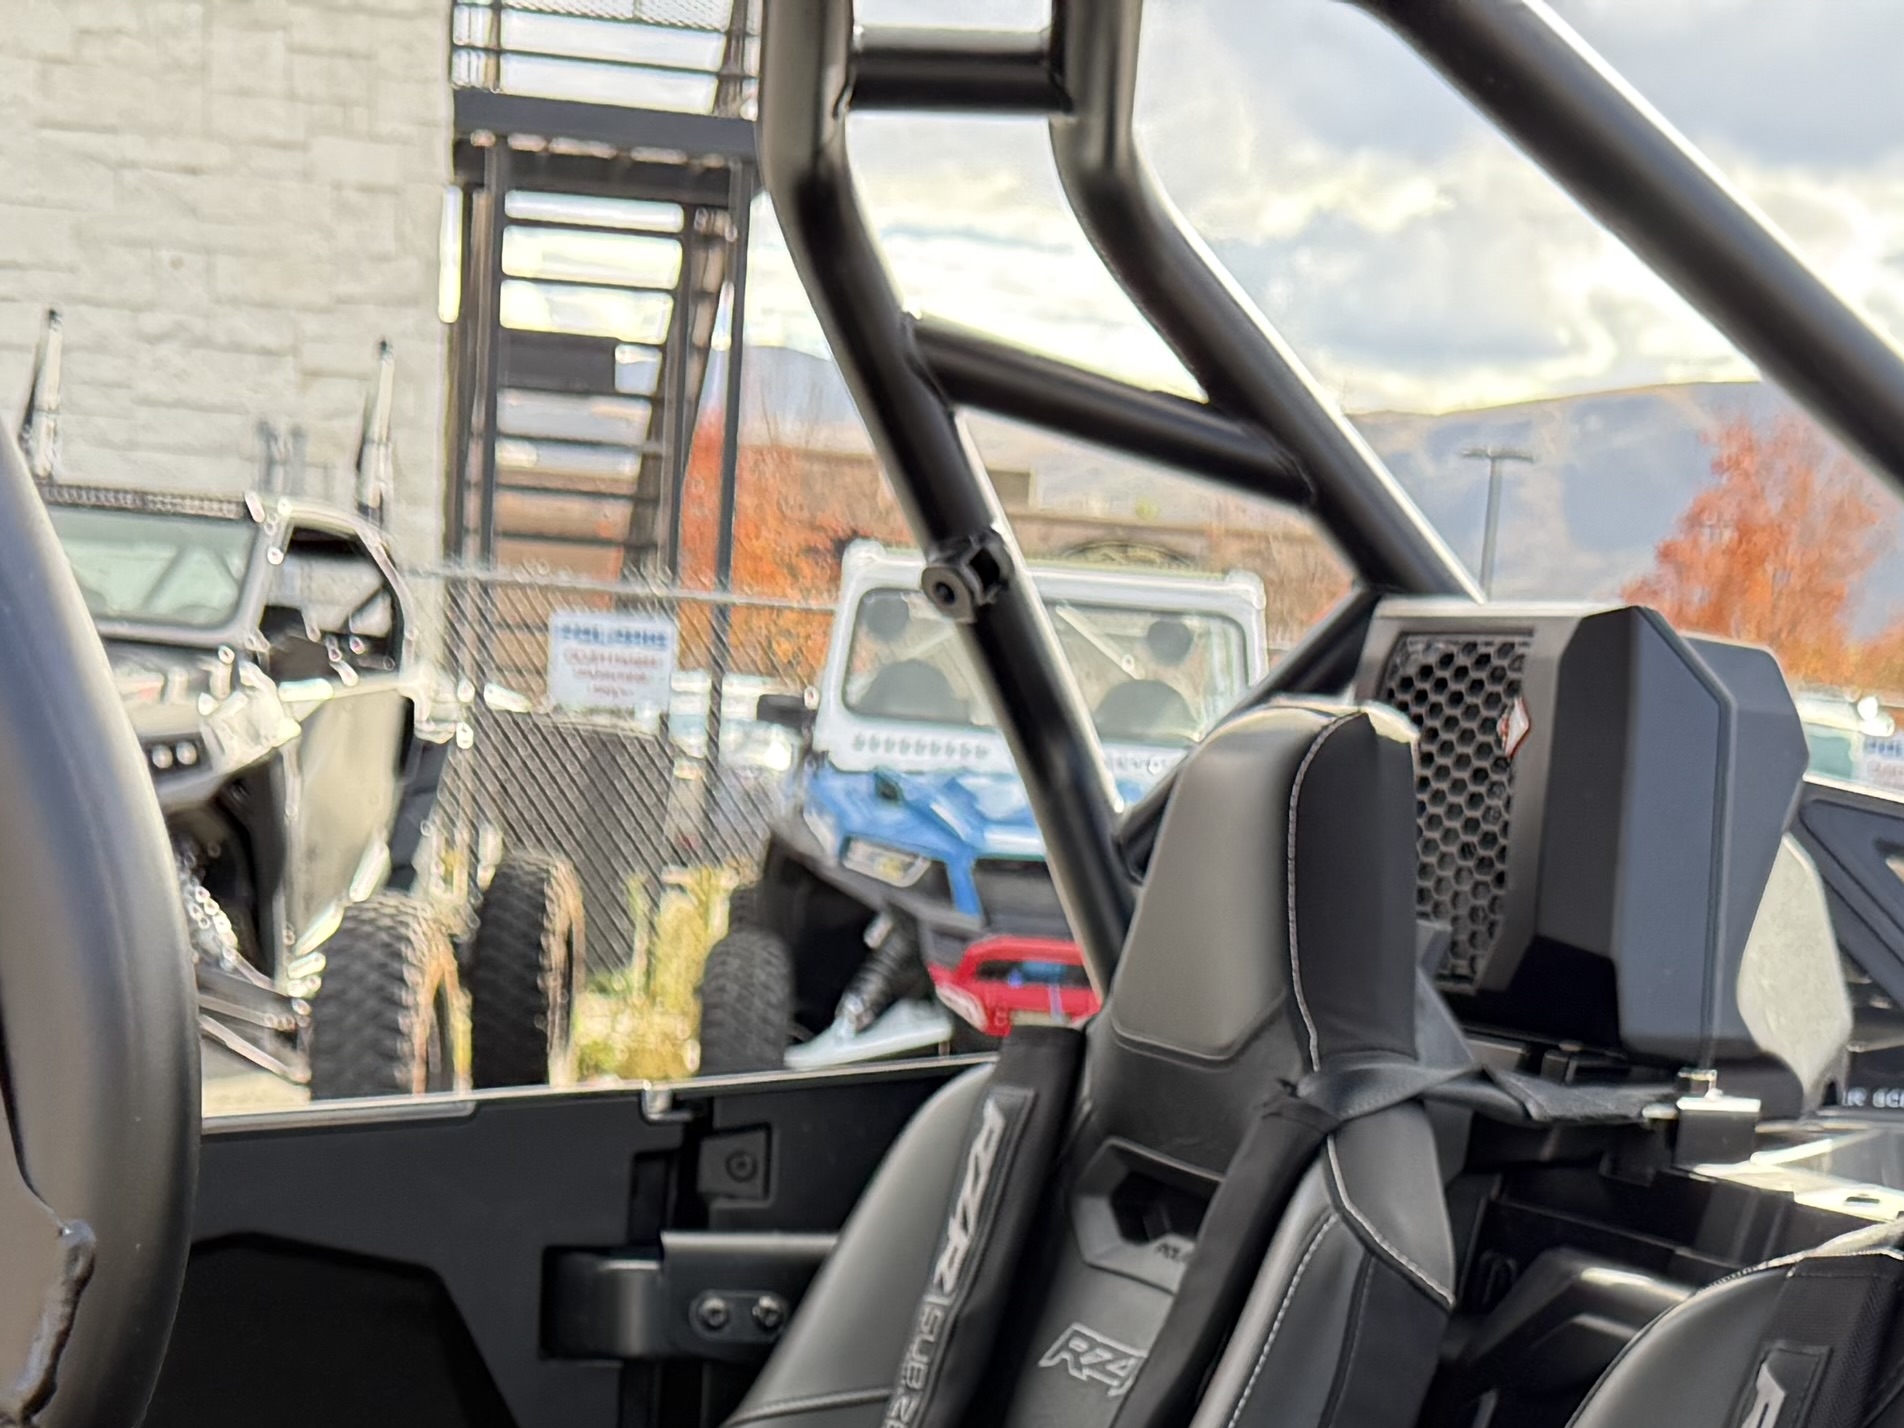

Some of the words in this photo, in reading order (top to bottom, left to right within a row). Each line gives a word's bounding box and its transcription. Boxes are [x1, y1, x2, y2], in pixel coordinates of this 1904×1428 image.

[934, 1098, 1005, 1294] RZR
[904, 1307, 946, 1391] SUB
[1038, 1321, 1149, 1398] RZ
